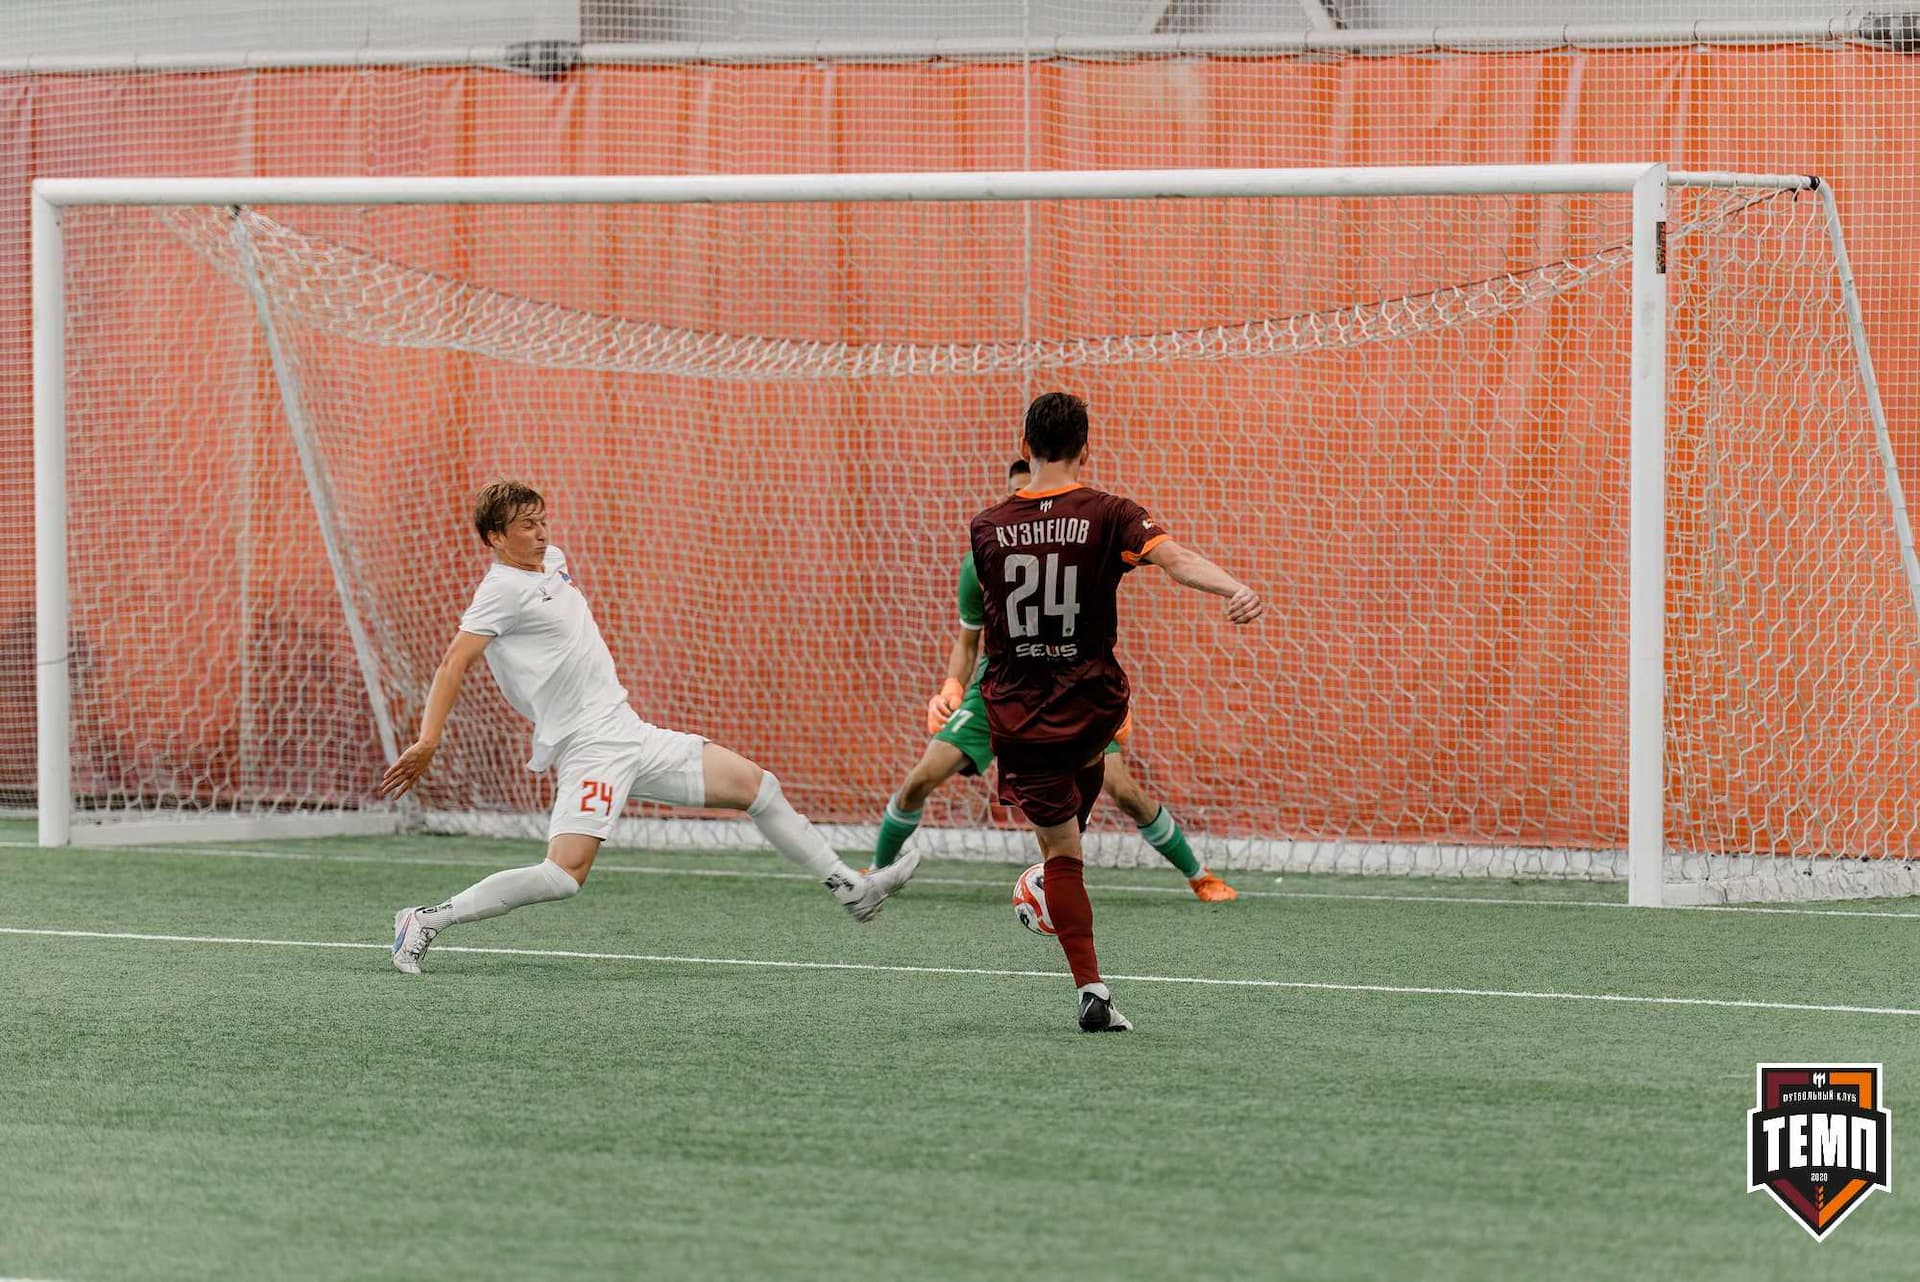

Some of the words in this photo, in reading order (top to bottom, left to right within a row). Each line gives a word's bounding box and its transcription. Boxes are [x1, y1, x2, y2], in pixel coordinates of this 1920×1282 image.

[996, 518, 1090, 548] КУЗНЕЦОВ
[1004, 553, 1081, 638] 24
[580, 780, 613, 817] 24
